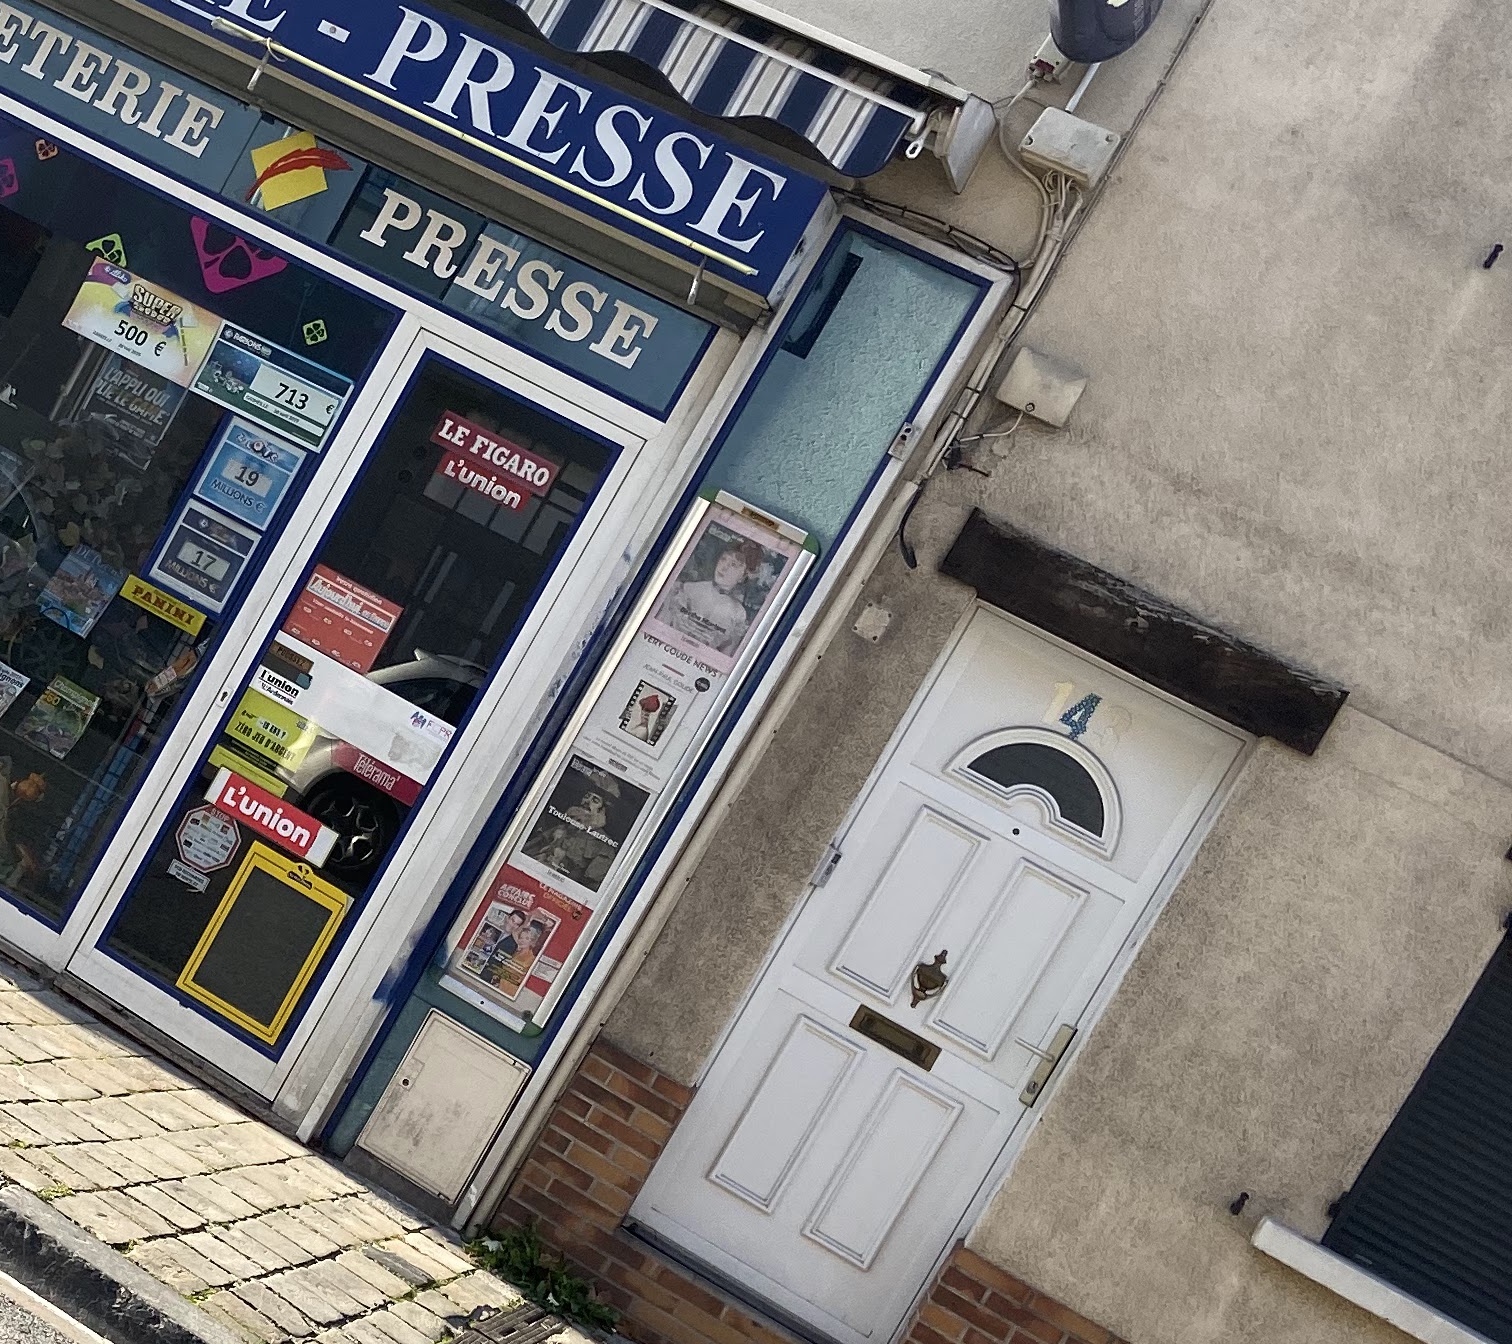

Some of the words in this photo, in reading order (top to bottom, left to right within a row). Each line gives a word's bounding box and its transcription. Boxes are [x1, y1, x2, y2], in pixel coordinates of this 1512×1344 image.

[363, 4, 787, 254] PRESSE
[359, 187, 660, 370] PRESSE
[133, 283, 183, 319] SUPER
[114, 319, 149, 347] 500
[154, 341, 167, 357] €
[274, 382, 309, 410] 713
[326, 404, 335, 415] €
[438, 418, 470, 446] LE
[470, 434, 550, 488] FIGARO
[211, 479, 253, 506] MILLIONS
[234, 465, 259, 487] 19
[444, 459, 522, 510] L'union
[165, 559, 208, 589] MILLIONS
[190, 550, 217, 571] 17
[131, 583, 196, 626] PANINI
[641, 631, 663, 648] VERY
[692, 659, 718, 678] NEWS
[222, 785, 311, 848] L'union
